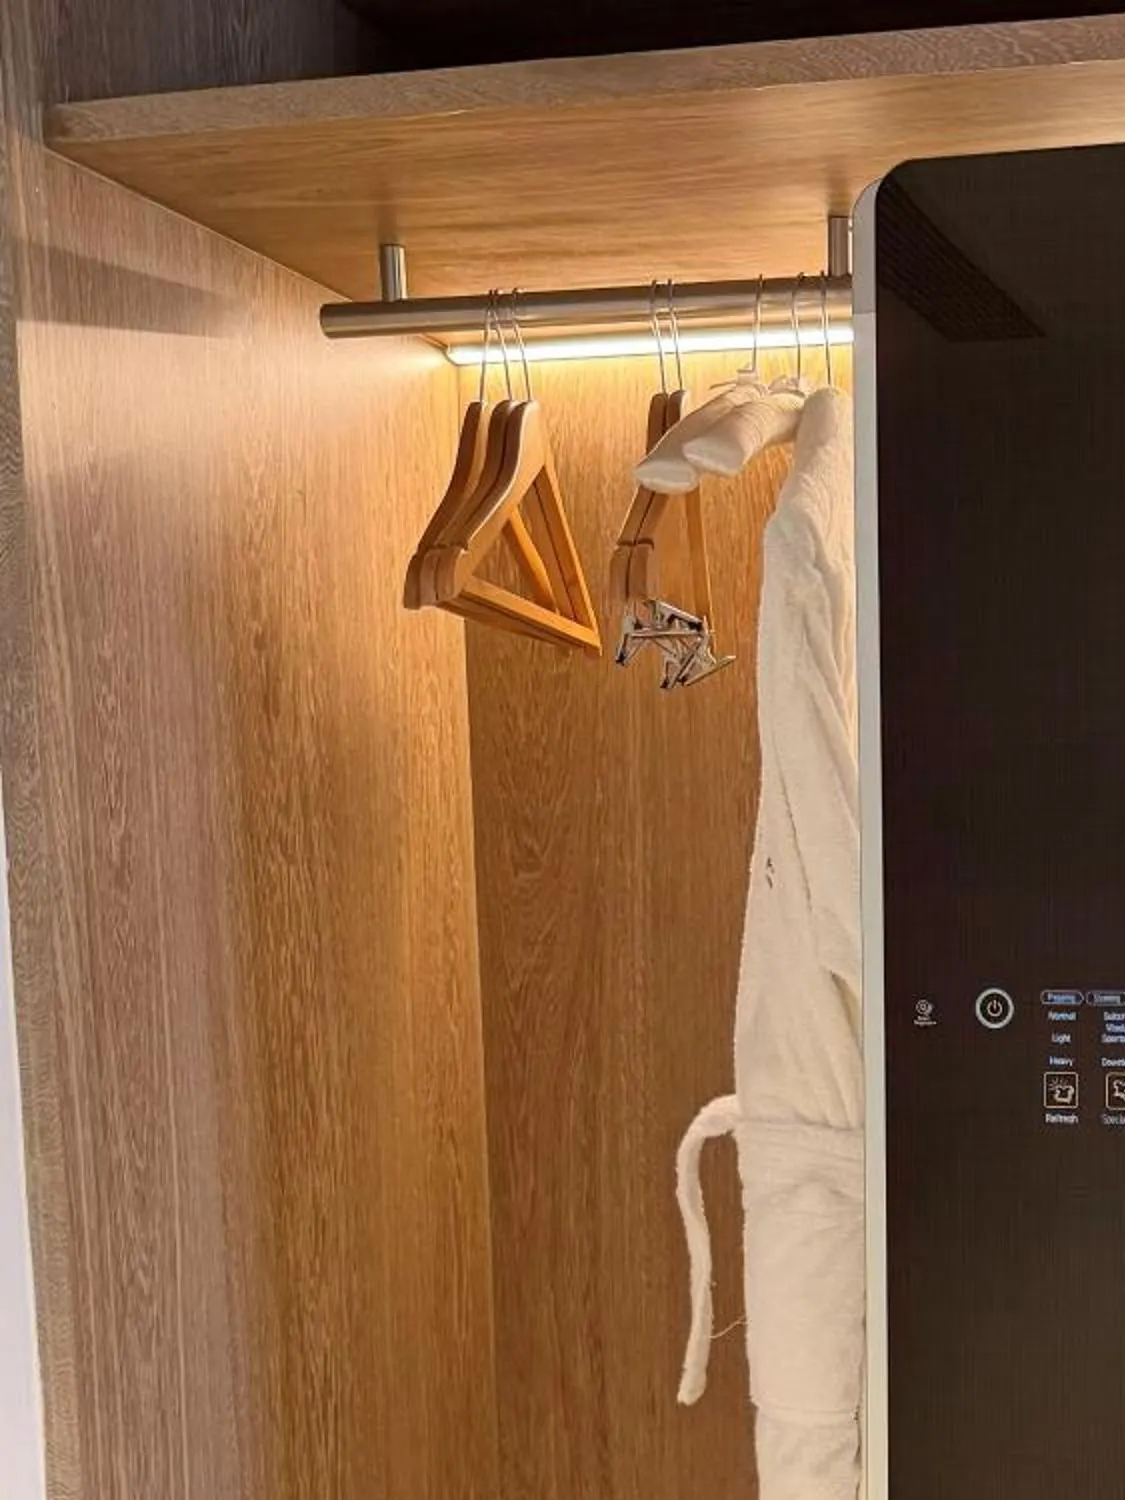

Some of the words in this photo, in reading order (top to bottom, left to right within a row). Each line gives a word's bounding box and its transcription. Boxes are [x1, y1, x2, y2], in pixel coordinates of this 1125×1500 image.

[1047, 1011, 1077, 1021] Normal
[1051, 1033, 1071, 1044] Light
[1048, 1056, 1073, 1067] Heavy
[1045, 1112, 1079, 1124] Refresh
